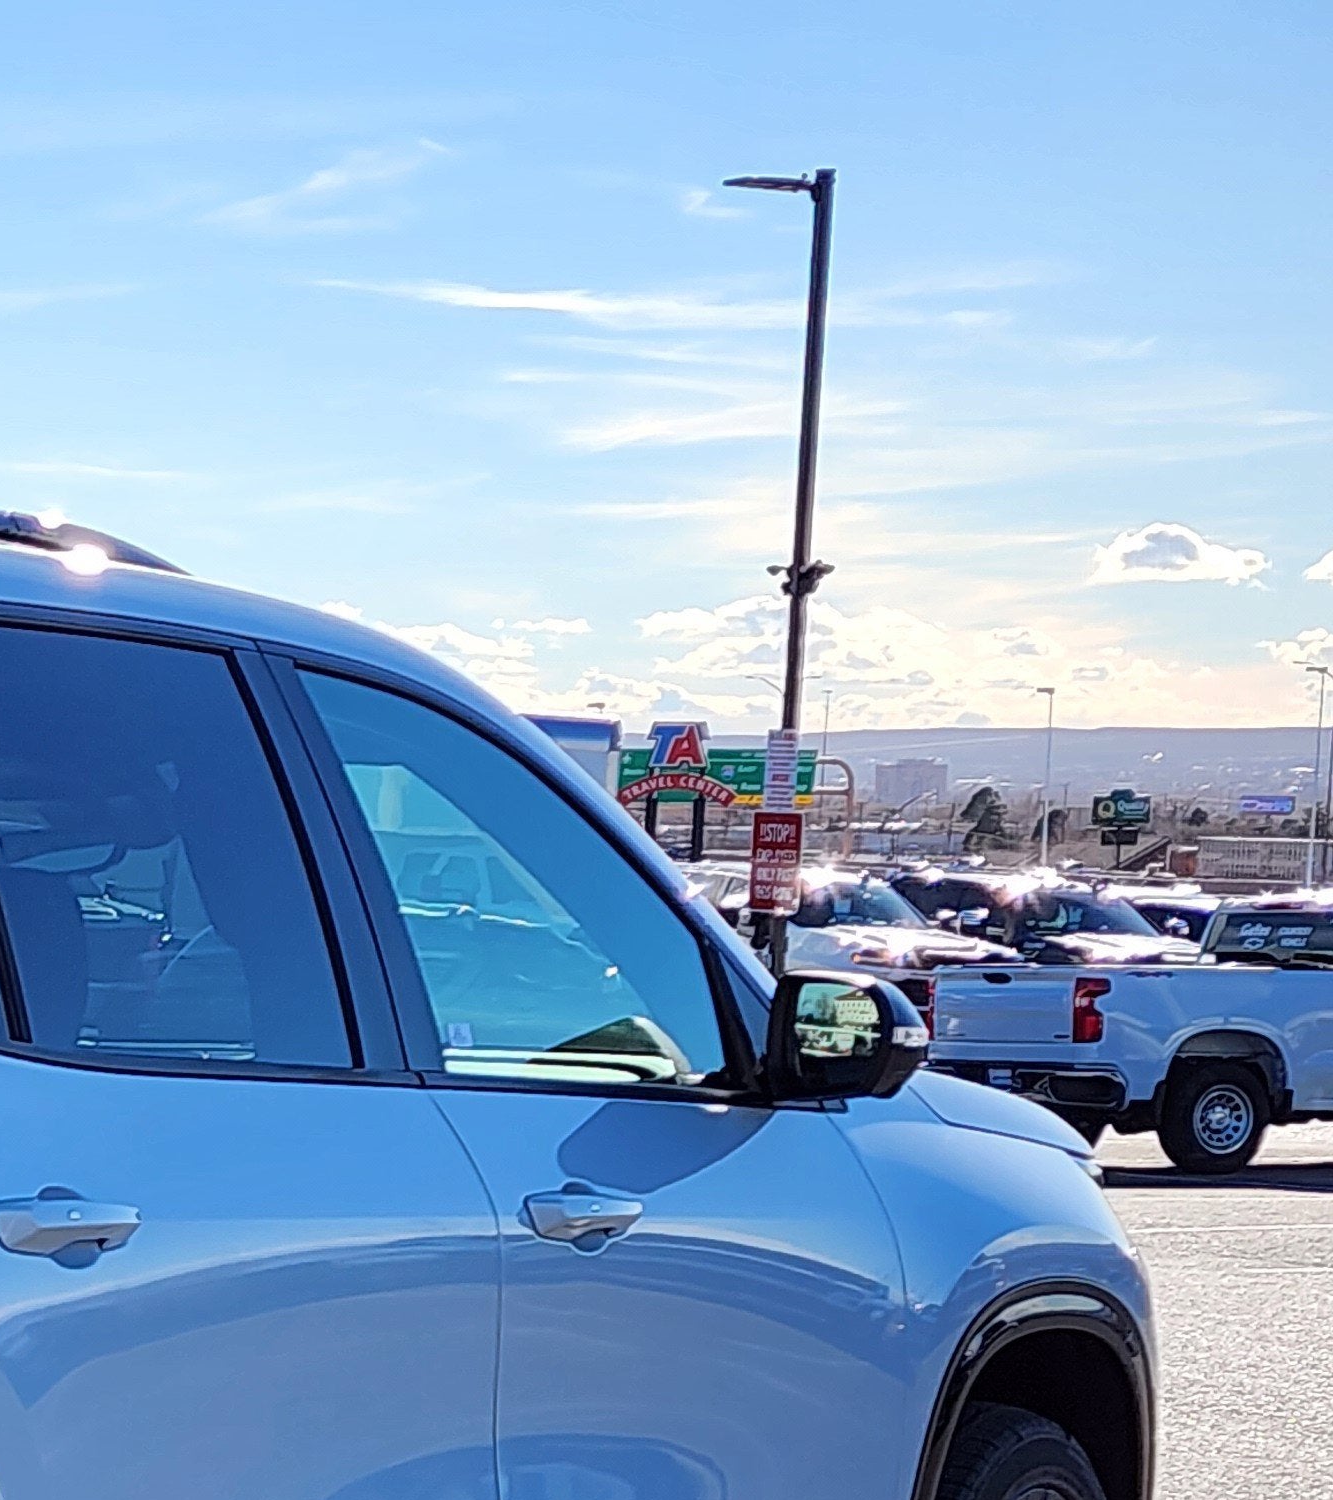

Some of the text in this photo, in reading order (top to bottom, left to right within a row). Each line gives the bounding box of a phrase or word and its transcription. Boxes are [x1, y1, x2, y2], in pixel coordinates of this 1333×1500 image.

[649, 723, 706, 767] TA
[622, 775, 730, 802] TRAVEL CENTER
